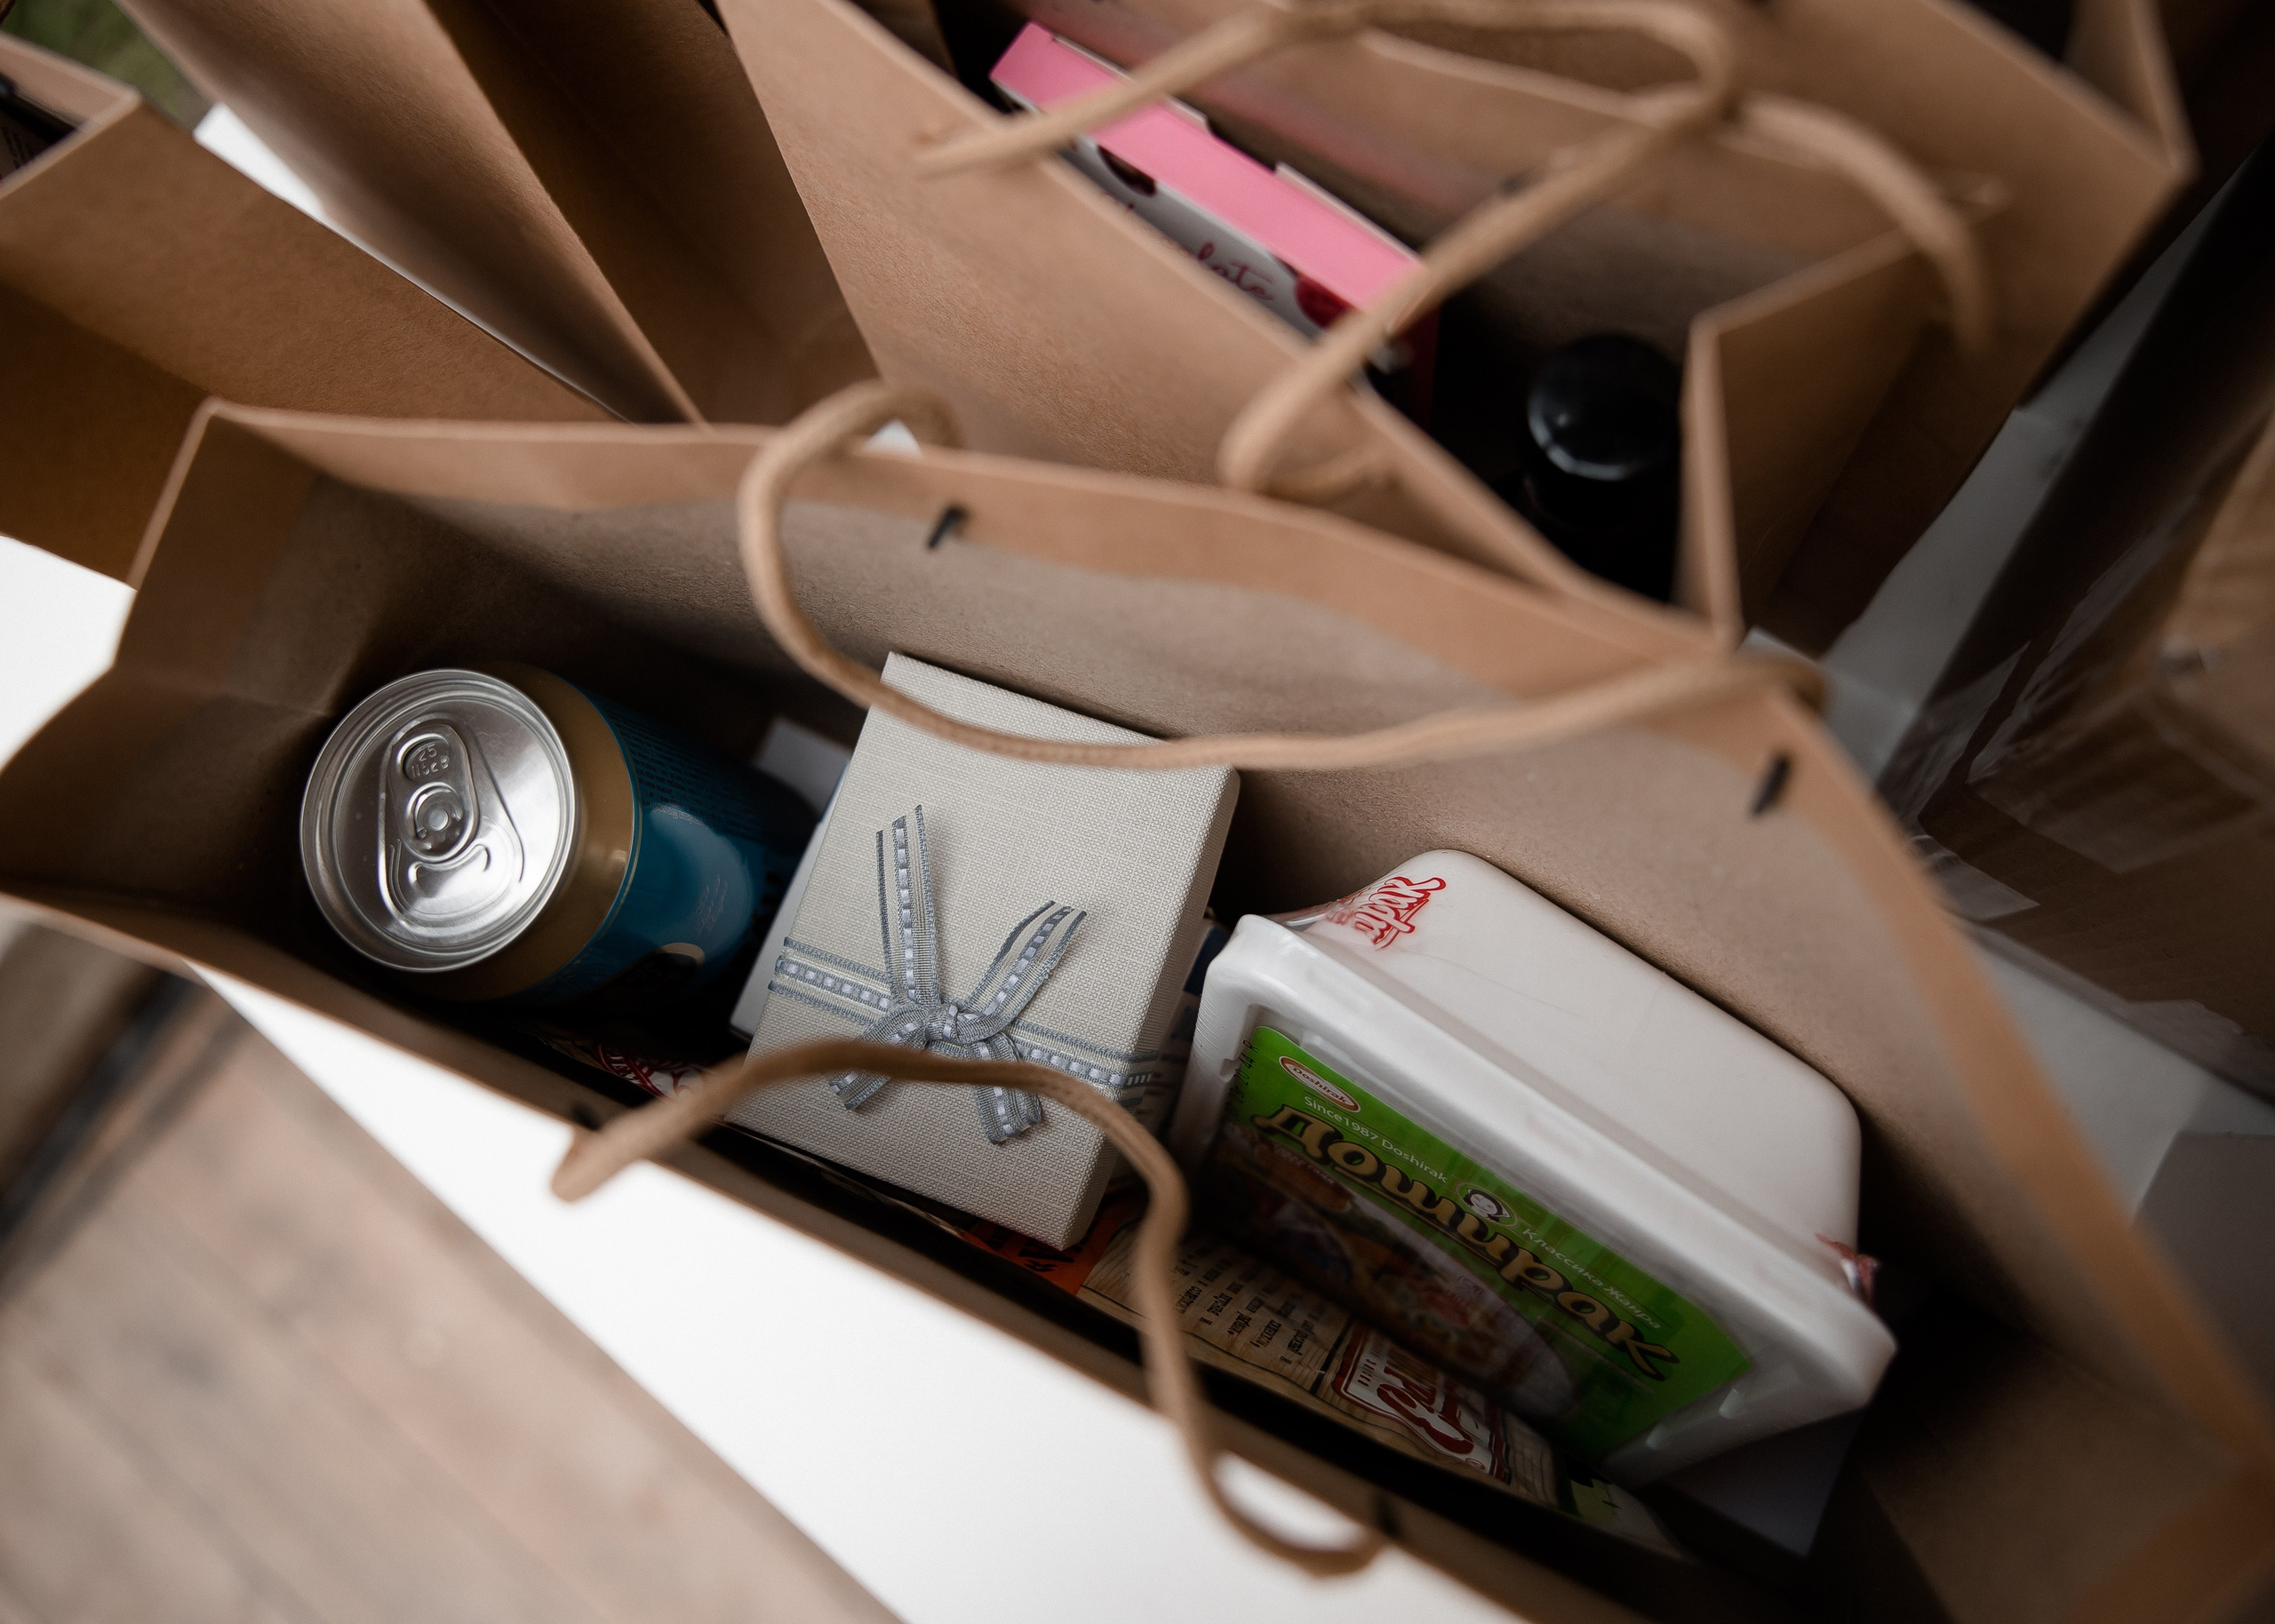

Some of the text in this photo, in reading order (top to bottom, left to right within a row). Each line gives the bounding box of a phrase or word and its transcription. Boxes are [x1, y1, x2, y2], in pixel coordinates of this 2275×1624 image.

[1291, 1065, 1350, 1106] Doshirak
[1381, 1138, 1449, 1184] Doshirak
[1250, 1103, 1680, 1382] Доширак
[1522, 1228, 1661, 1329] Классика Жанра
